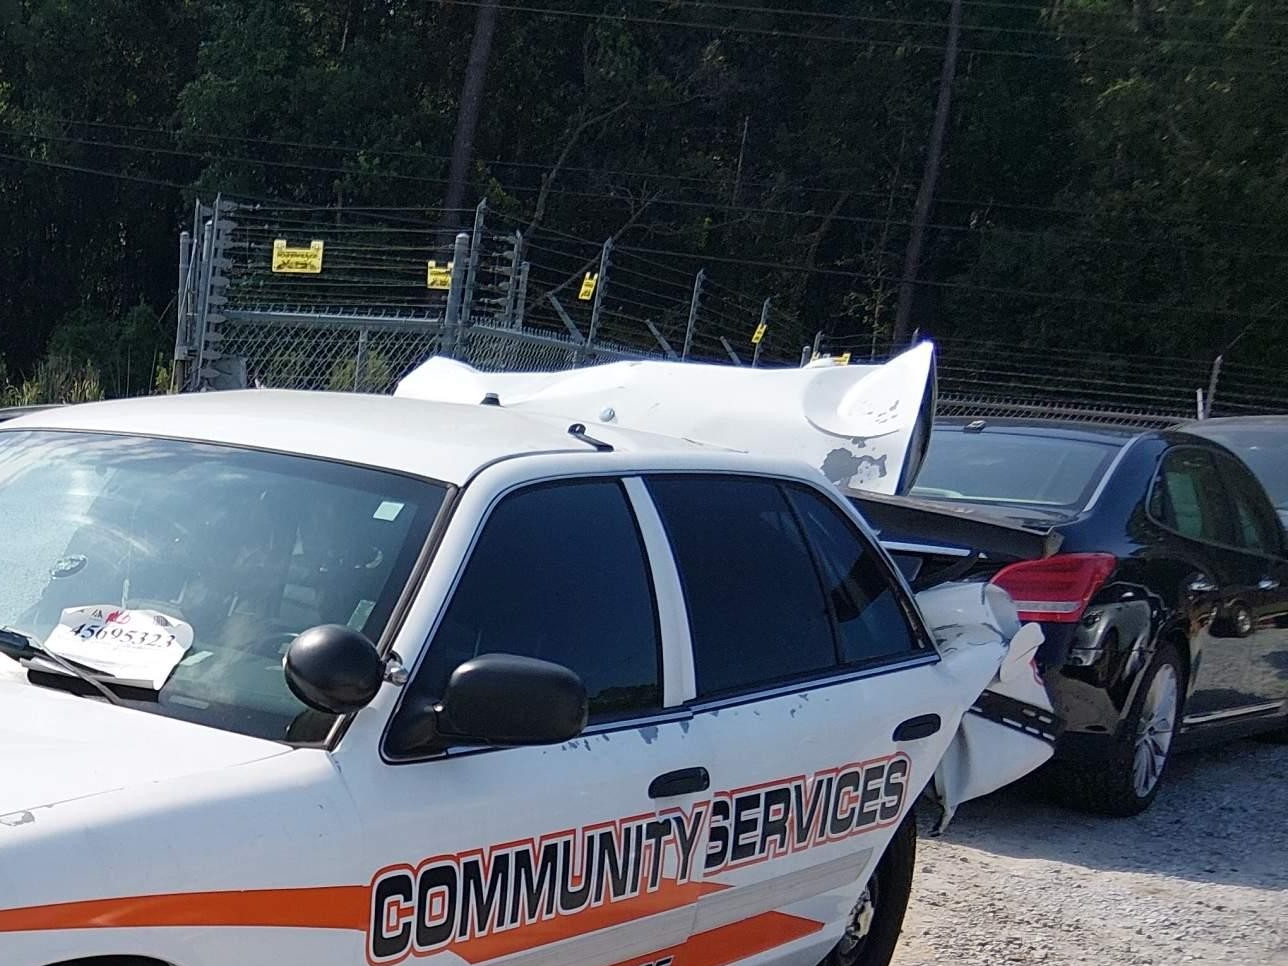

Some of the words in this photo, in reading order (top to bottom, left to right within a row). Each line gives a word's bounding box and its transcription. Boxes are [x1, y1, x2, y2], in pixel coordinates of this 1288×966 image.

[71, 622, 176, 648] 45695323
[369, 806, 705, 964] COMMUNITY
[703, 754, 910, 872] SERVICES
